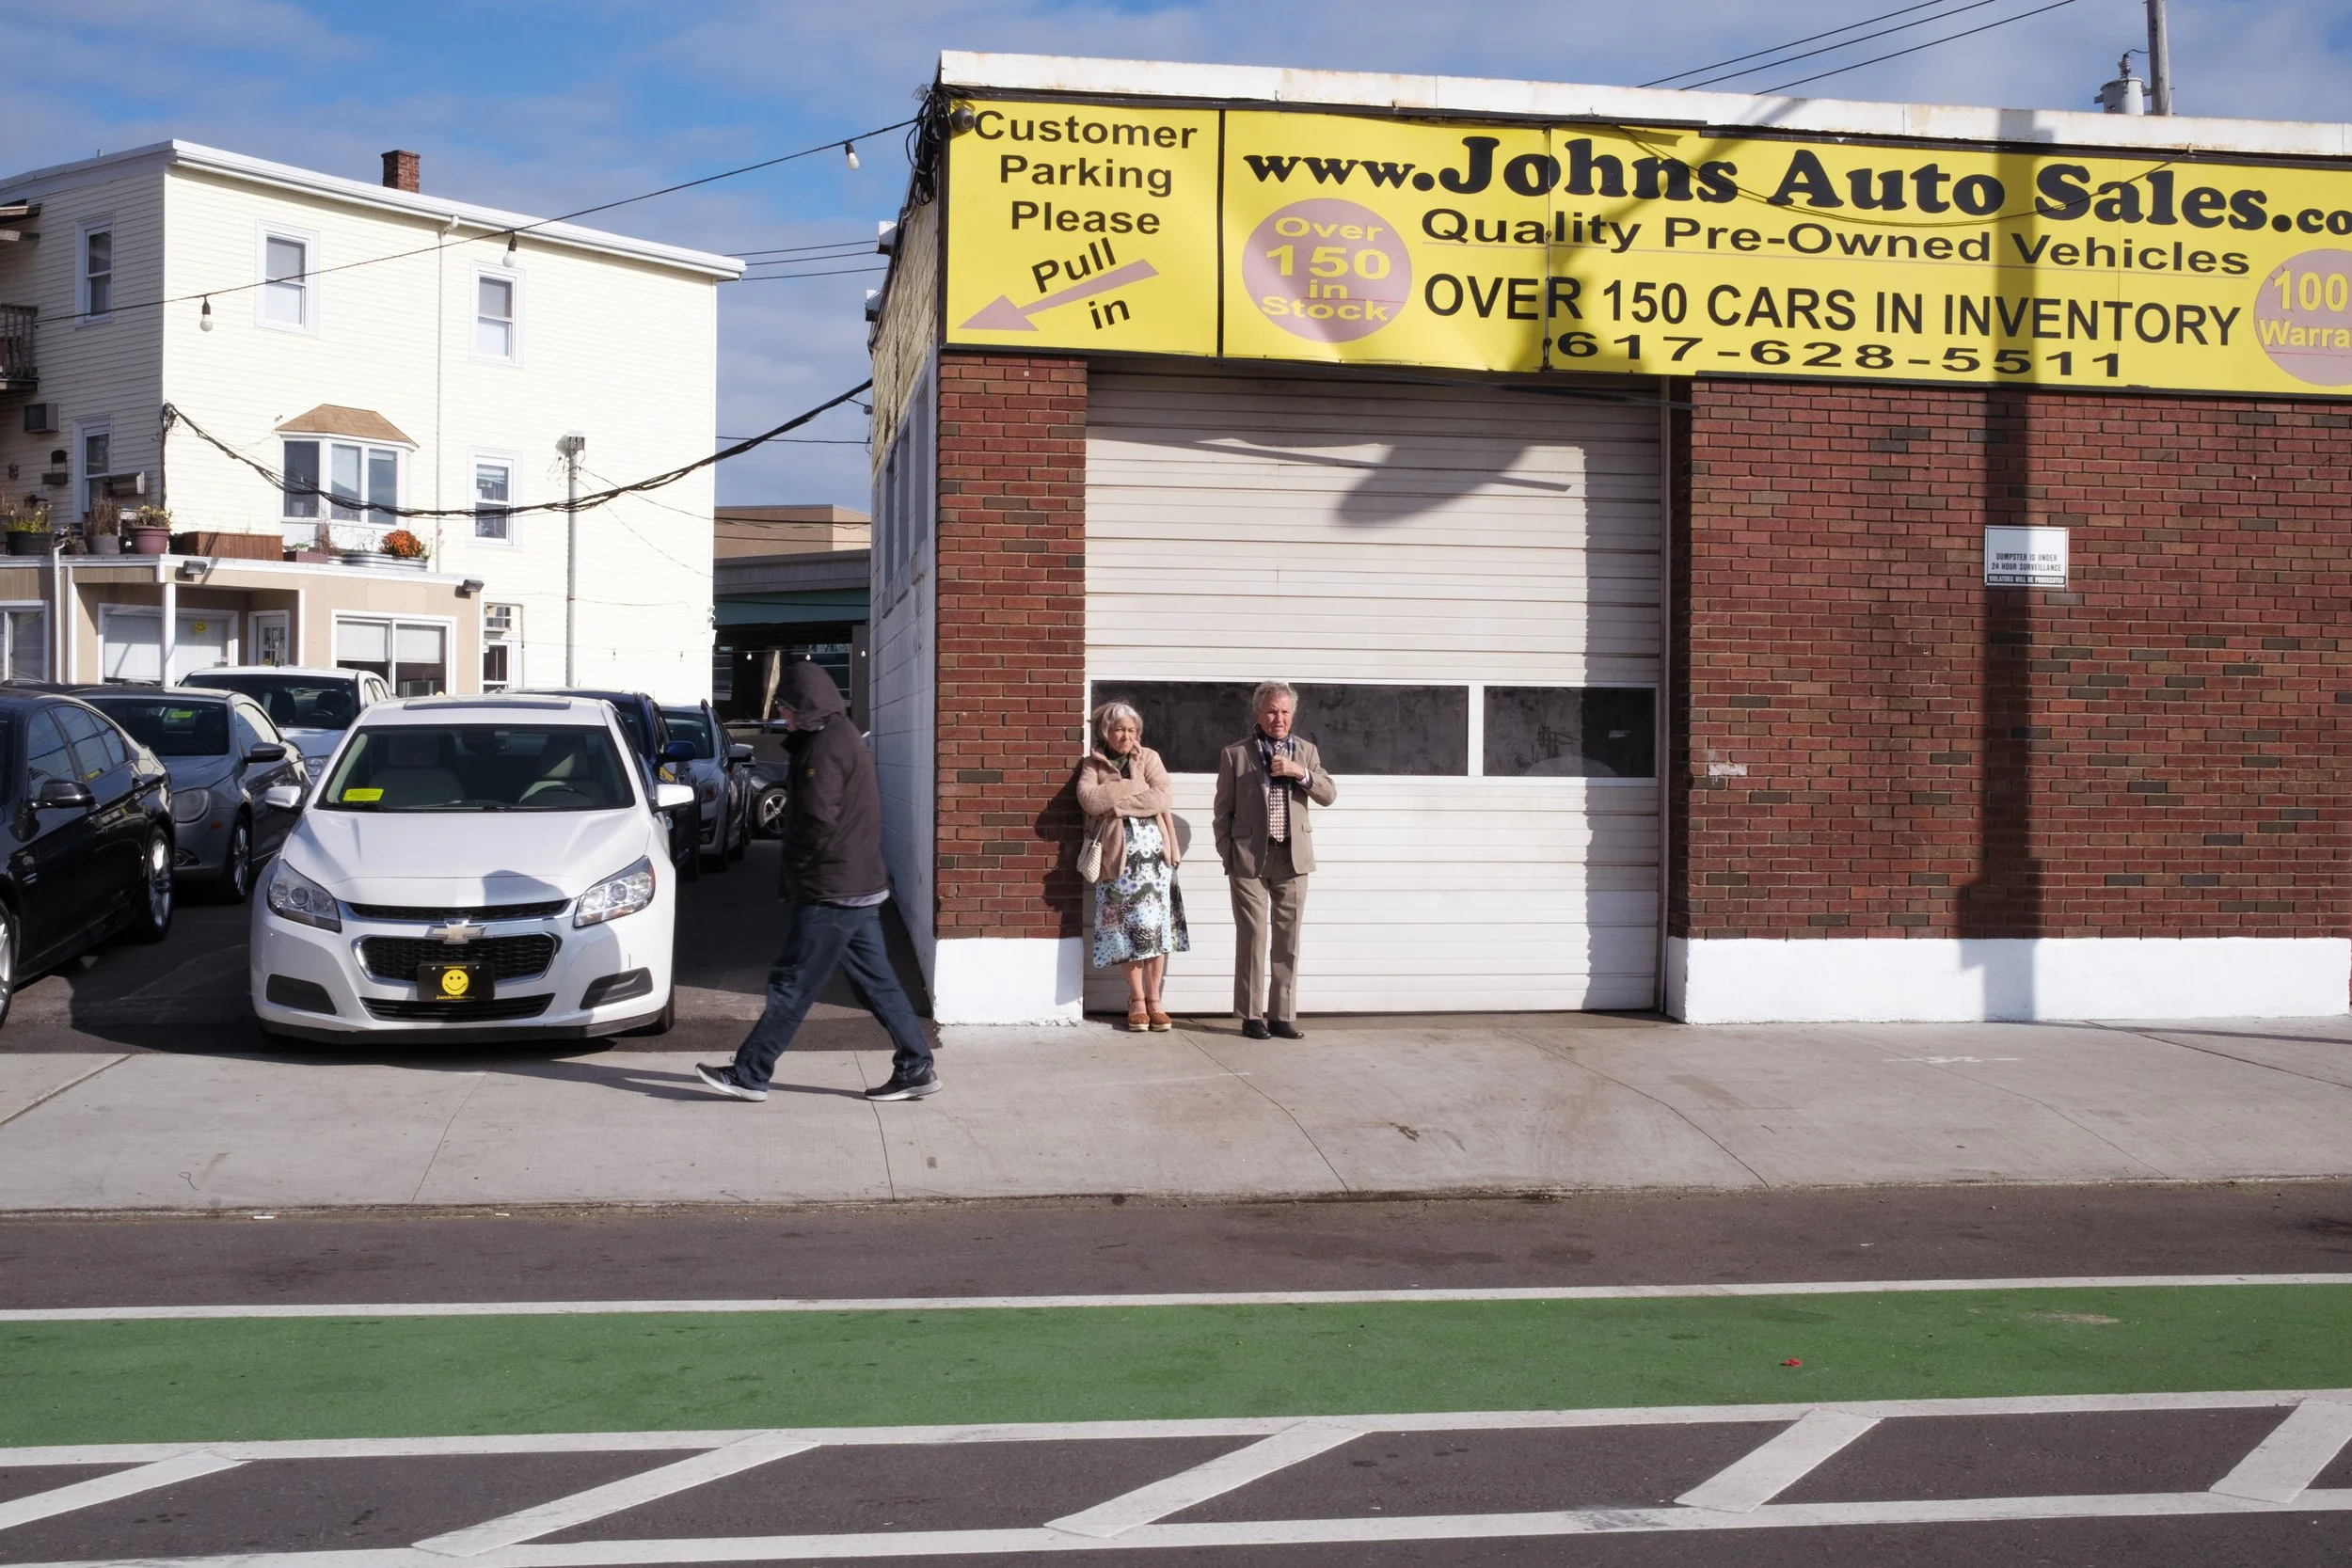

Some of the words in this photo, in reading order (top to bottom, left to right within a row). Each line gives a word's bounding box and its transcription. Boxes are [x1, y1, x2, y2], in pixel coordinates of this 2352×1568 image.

[974, 111, 1199, 149] Customer
[1000, 154, 1172, 198] Parking
[1767, 149, 2006, 215] Auto
[1011, 200, 1161, 234] Please
[1275, 216, 1384, 242] Over
[1422, 208, 1642, 253] Quality
[1665, 217, 1990, 261] Pre-Owned
[2010, 232, 2249, 275] Vehicles
[1031, 237, 1117, 293] Pull
[1266, 245, 1391, 280] 150
[1309, 278, 1347, 299] in
[2273, 269, 2349, 312] 100
[1088, 299, 1131, 329] in
[1262, 296, 1389, 323] Stock
[1424, 273, 1582, 321] OVER
[1603, 279, 1688, 325] 150
[1707, 284, 1855, 332] CARS
[1877, 292, 1922, 335] IN
[1945, 294, 2241, 346] INVENTORY
[1557, 332, 2119, 377] 617-628-5511
[1995, 552, 2027, 562] DUMPSTER
[2029, 553, 2036, 562] IS
[2001, 562, 2017, 571] HOUR
[2019, 563, 2061, 572] SURVEILLANCE
